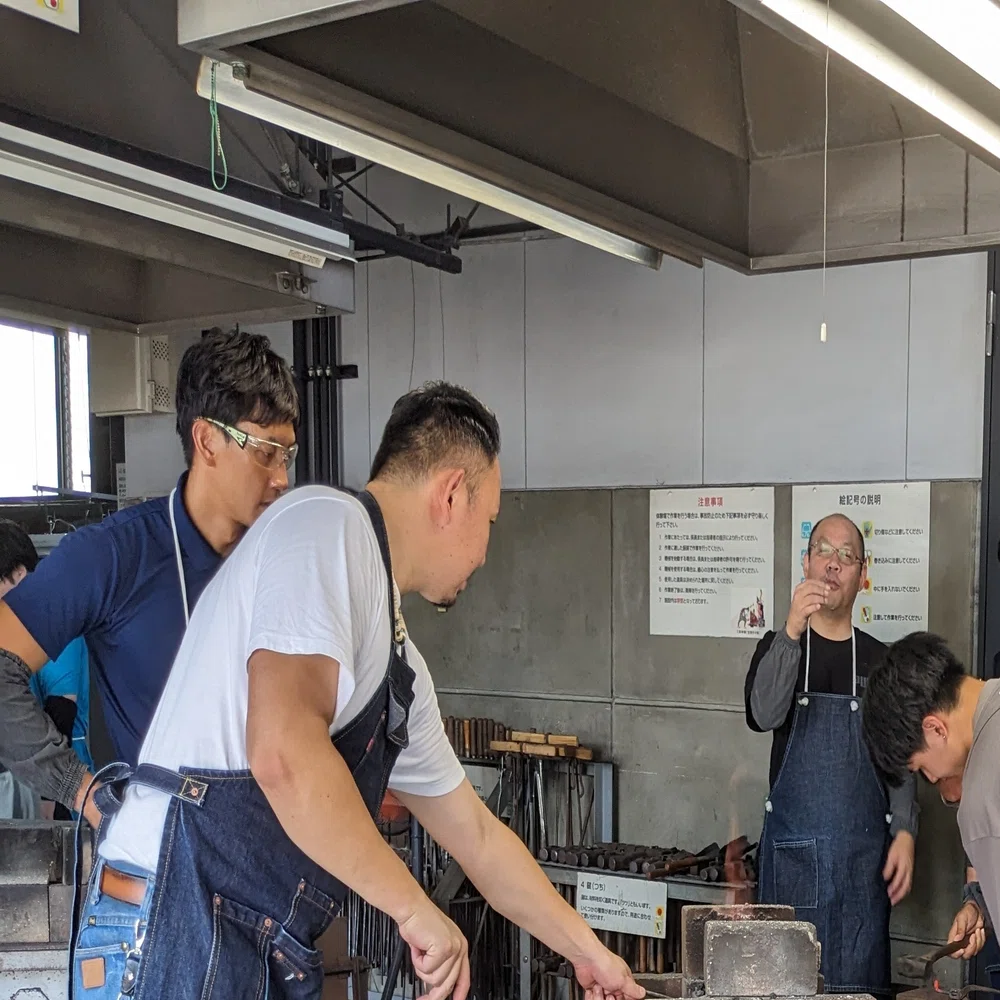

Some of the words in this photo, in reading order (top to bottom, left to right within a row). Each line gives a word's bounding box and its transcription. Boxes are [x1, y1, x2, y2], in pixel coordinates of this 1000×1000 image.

[697, 497, 724, 507] 注意事項
[839, 494, 882, 506] 絵記号の説明
[873, 557, 921, 565] 巻き込みに注意してください
[873, 585, 921, 593] 中に手を入れないでください
[873, 614, 923, 622] 注意して作業を行ってください
